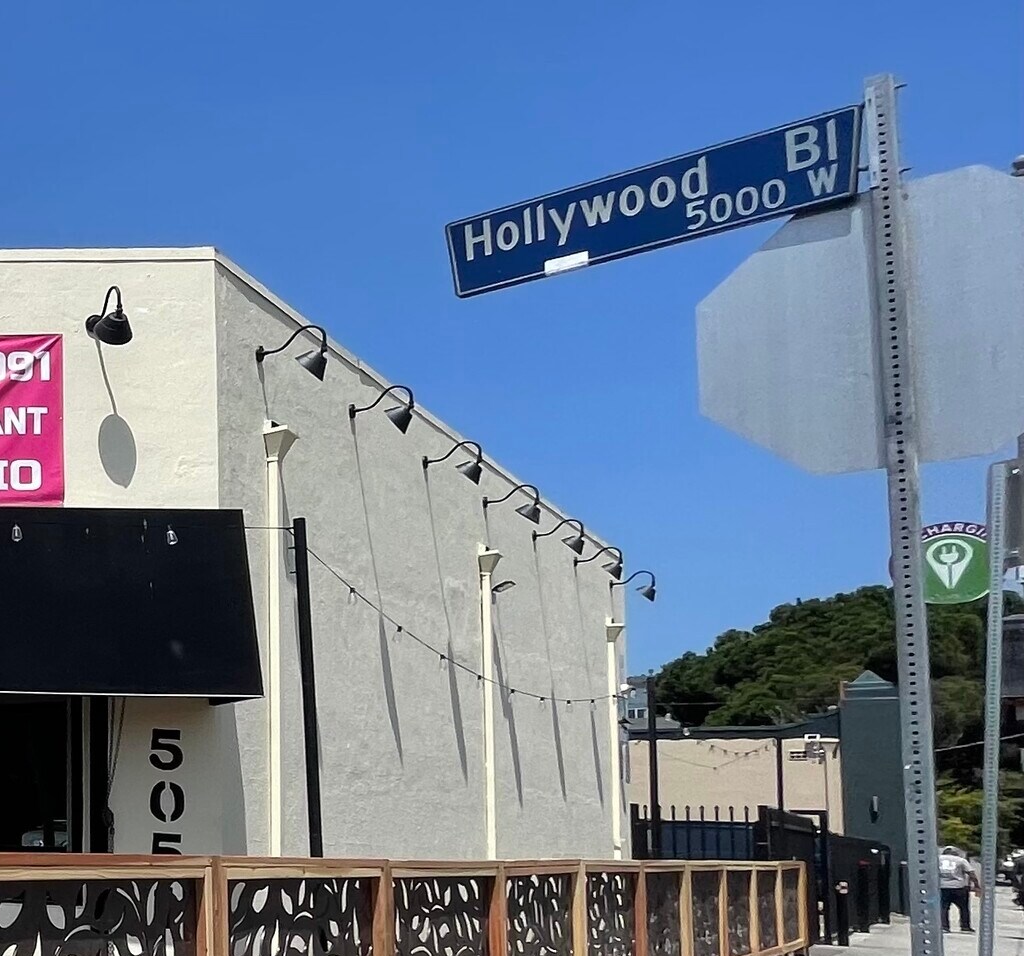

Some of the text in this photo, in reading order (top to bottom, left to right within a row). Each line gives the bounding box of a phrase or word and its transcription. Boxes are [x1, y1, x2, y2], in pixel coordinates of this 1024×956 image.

[464, 118, 838, 261] Hollywood Bl
[685, 163, 839, 231] 5000 W
